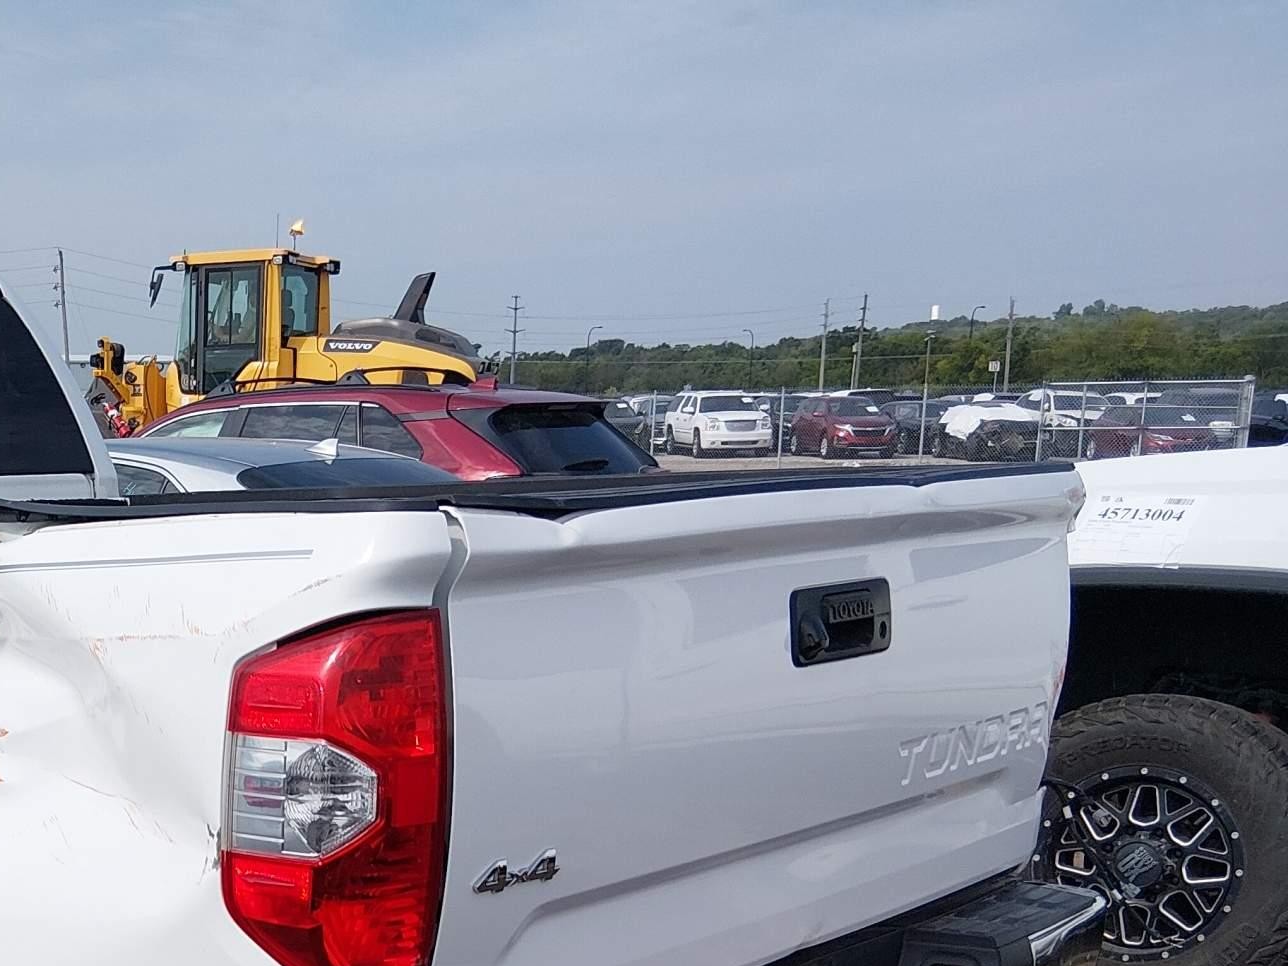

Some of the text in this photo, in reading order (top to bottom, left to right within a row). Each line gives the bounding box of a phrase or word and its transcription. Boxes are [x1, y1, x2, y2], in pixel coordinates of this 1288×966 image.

[328, 342, 372, 350] VOLVO
[1097, 507, 1186, 522] 45713004
[827, 599, 875, 622] TOYOTA
